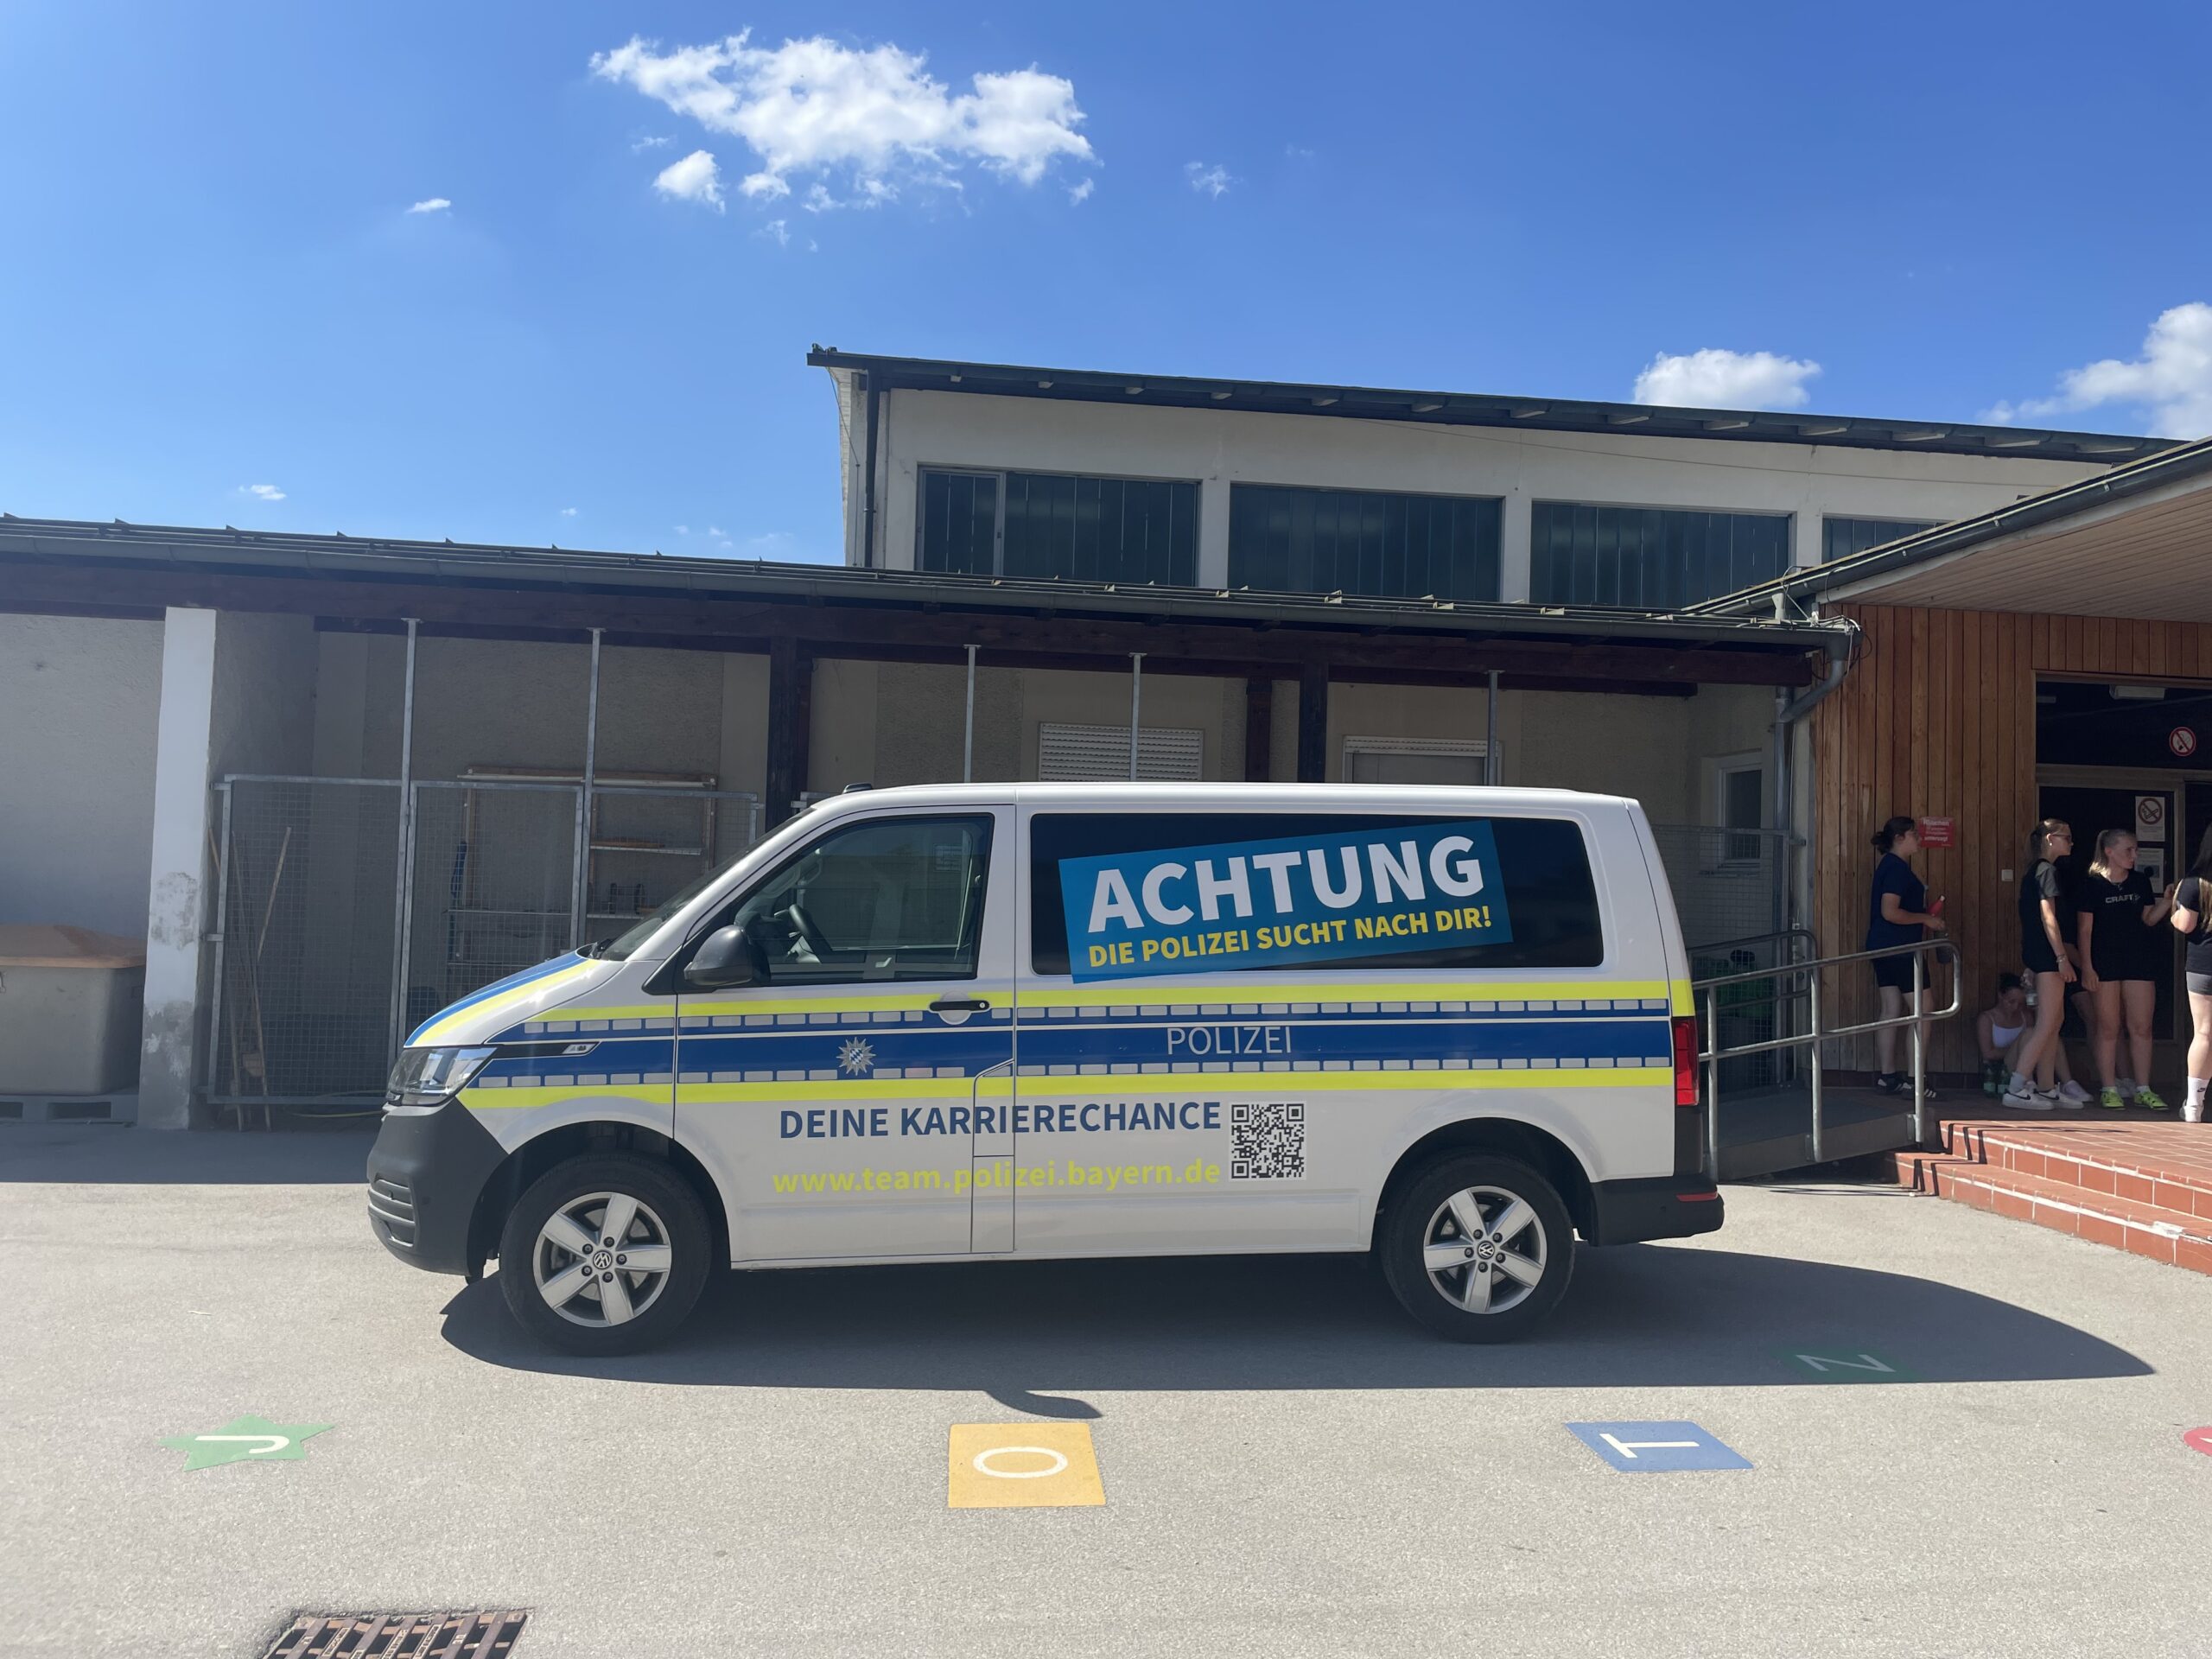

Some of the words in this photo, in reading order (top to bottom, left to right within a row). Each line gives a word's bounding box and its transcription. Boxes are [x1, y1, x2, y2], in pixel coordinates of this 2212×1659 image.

[1088, 836, 1484, 933] ACHTUNG
[2105, 894, 2133, 904] CRAFT
[1089, 942, 1135, 967] DIE
[1141, 930, 1249, 962] POLIZEI
[1256, 919, 1347, 949] SUCHT
[1354, 912, 1429, 939] NACH
[1437, 906, 1492, 931] DIR!
[1166, 1027, 1292, 1055] POLIZEI
[779, 1108, 889, 1139] DEINE
[901, 1101, 1222, 1135] KARRIERECHANCE
[772, 1158, 1221, 1194] www.team.polizei.bayern.de
[1599, 1433, 1700, 1459] T
